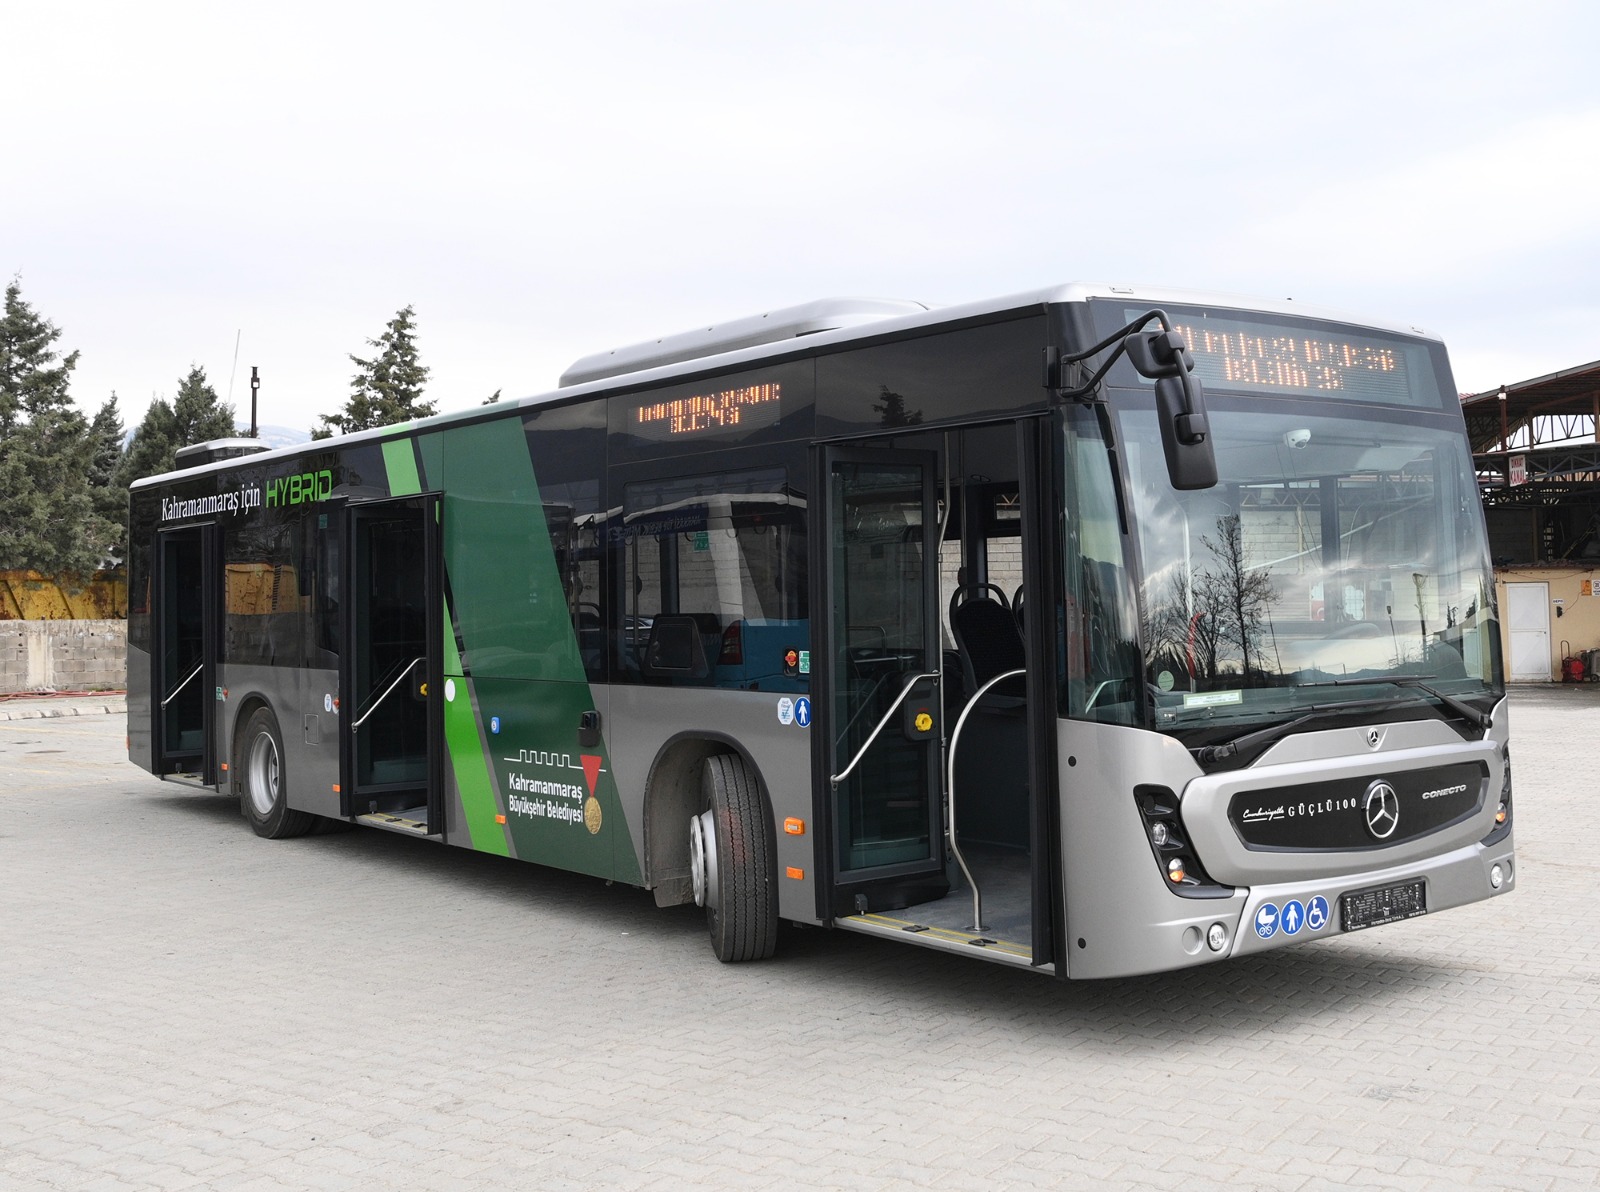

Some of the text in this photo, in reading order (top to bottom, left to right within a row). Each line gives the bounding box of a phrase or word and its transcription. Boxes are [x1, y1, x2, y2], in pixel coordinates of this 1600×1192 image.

[162, 470, 333, 521] Kahramanmaraş için HYBRID
[509, 772, 583, 804] Kahramanmaraş
[1422, 784, 1467, 800] CONECTO
[509, 794, 584, 826] Büyükşehir Belediyesi
